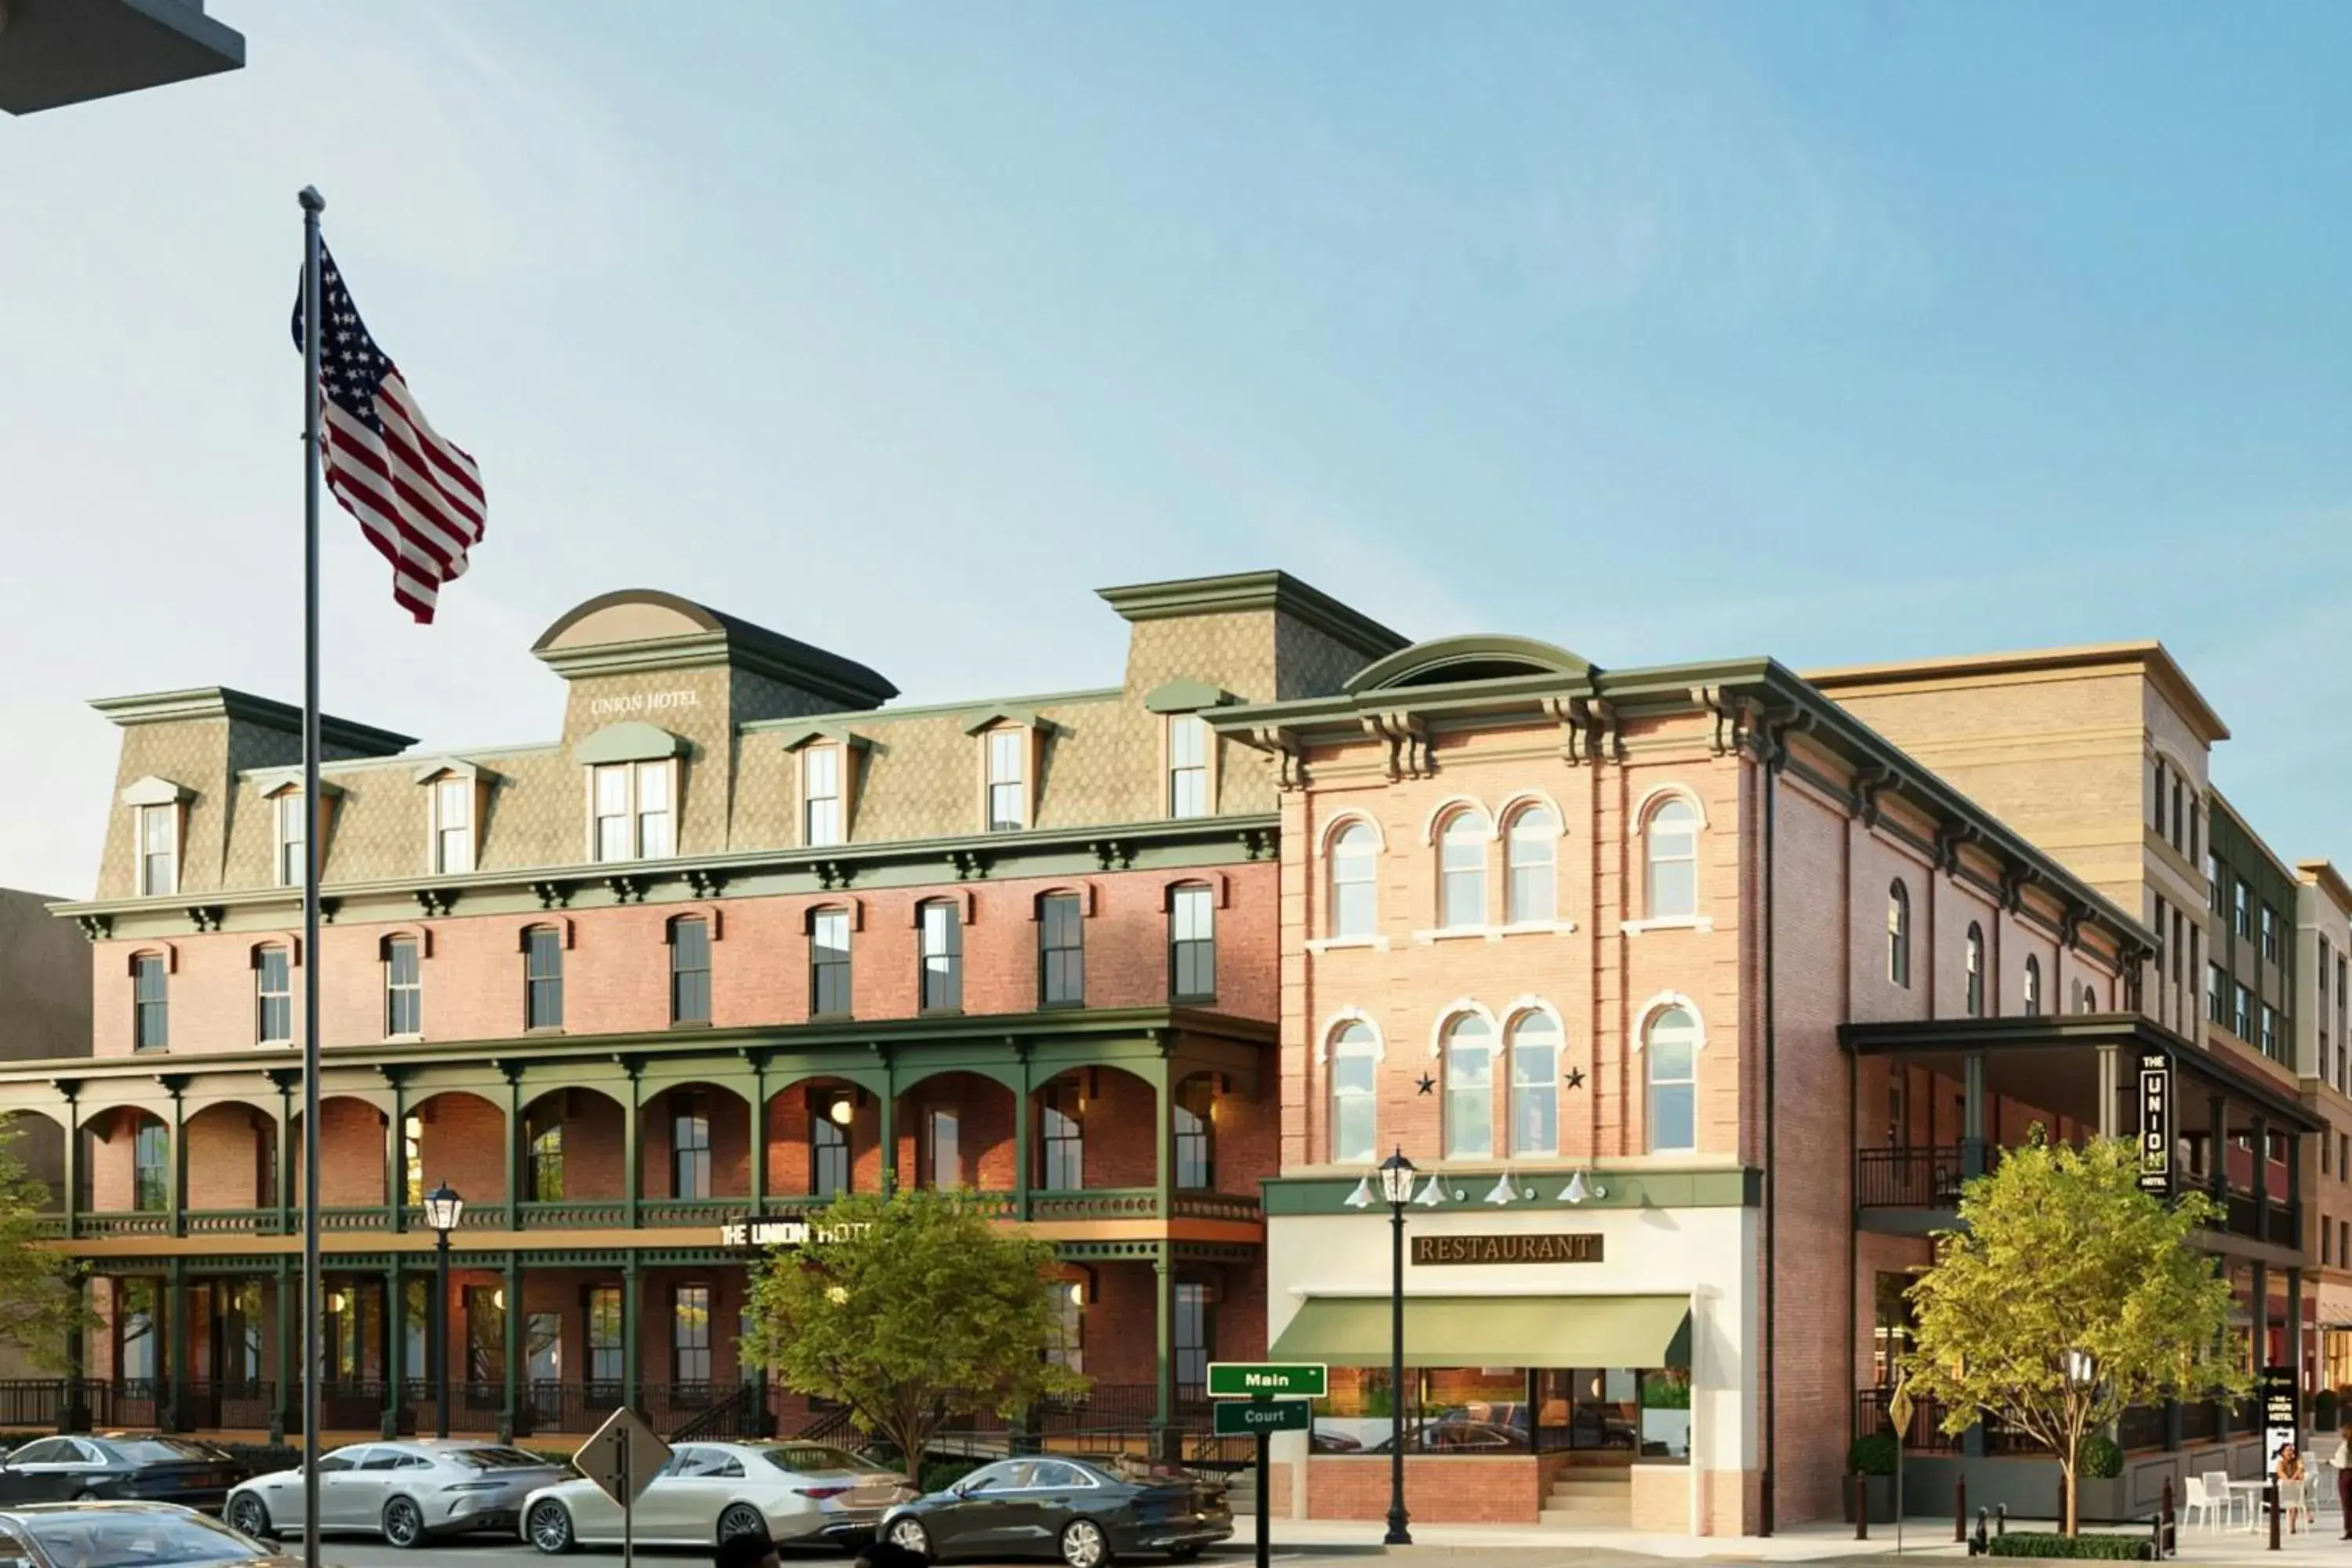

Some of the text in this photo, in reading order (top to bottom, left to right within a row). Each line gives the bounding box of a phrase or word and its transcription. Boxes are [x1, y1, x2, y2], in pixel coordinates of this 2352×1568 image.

[591, 690, 699, 715] UNION HOTEL
[2142, 1056, 2165, 1069] THE
[2141, 1177, 2167, 1186] HOTEL
[721, 1225, 747, 1245] THE
[752, 1223, 810, 1244] UNION
[1420, 1235, 1592, 1261] RESTAURANT
[1245, 1374, 1290, 1387] Main
[1245, 1410, 1285, 1423] Court
